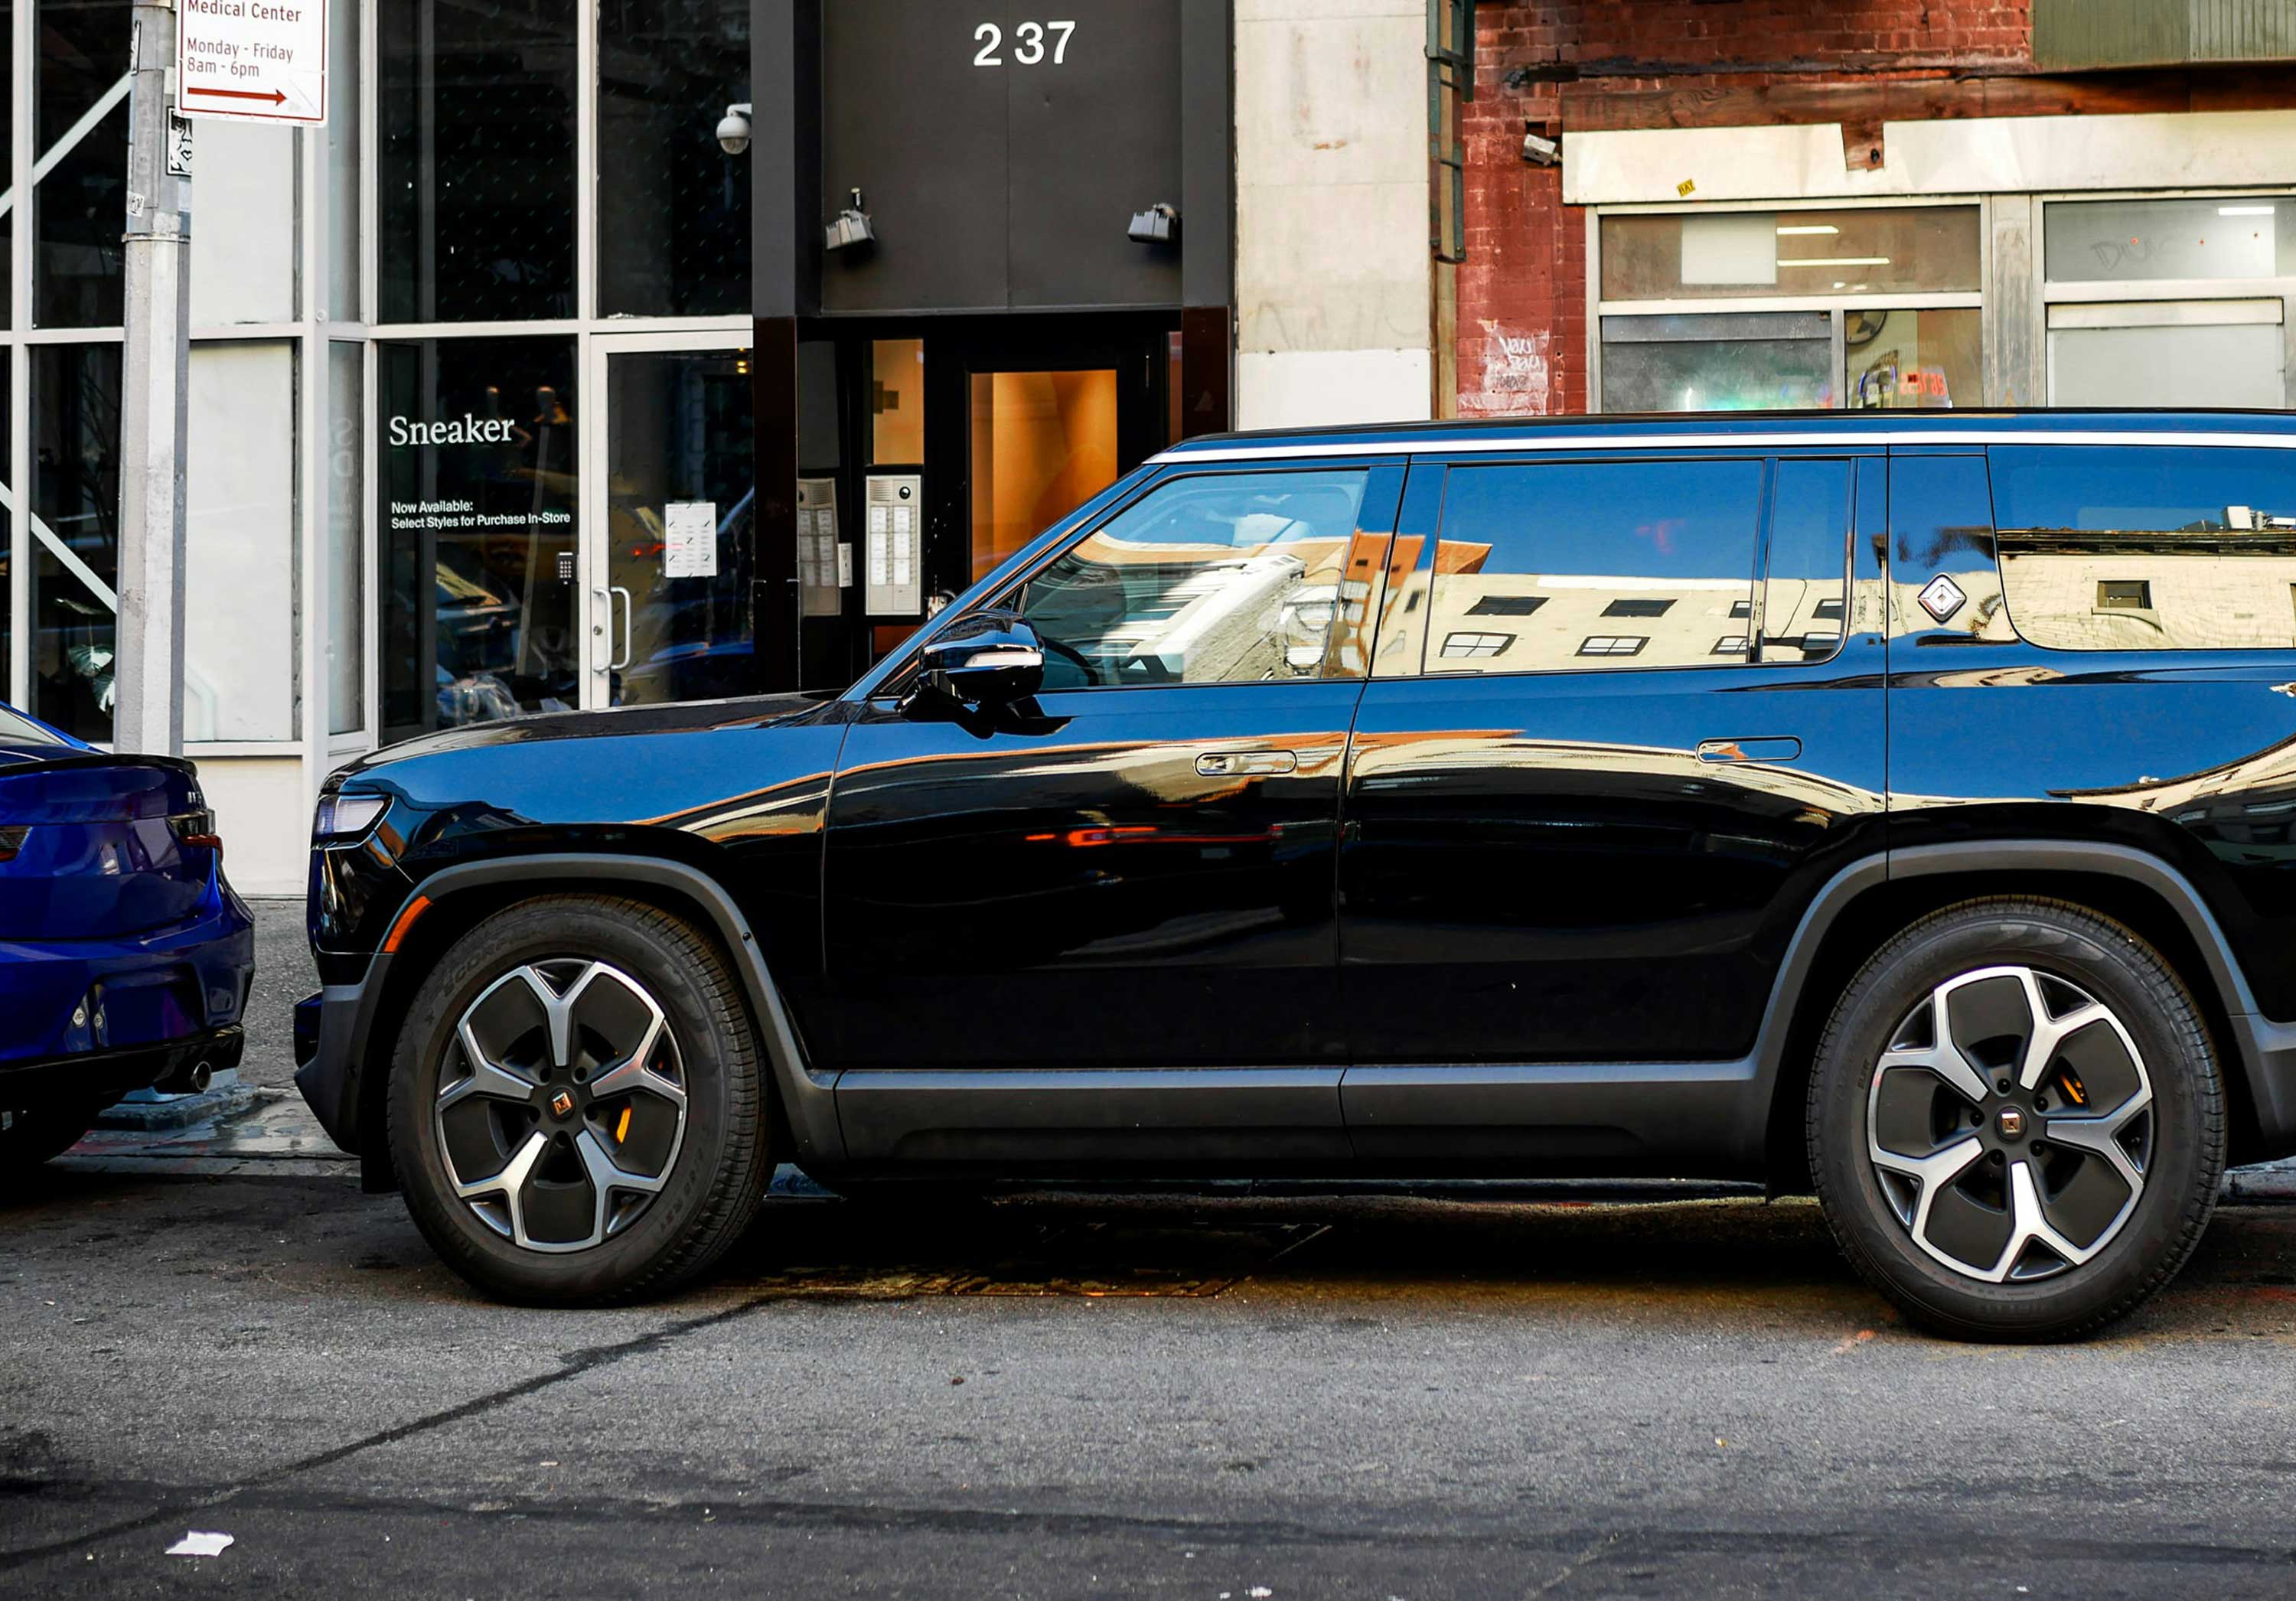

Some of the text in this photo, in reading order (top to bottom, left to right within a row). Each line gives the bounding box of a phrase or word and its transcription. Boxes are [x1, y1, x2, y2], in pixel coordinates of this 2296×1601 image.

[188, 0, 302, 22] Medical Center
[187, 37, 240, 59] Monday
[253, 43, 294, 64] Friday
[974, 21, 1076, 67] 237
[187, 57, 217, 73] 8am
[230, 61, 259, 79] 6pm
[389, 412, 515, 446] Sneaker
[391, 500, 474, 514] Now Available:
[391, 512, 571, 530] Select Styles for Purchase In-Store
